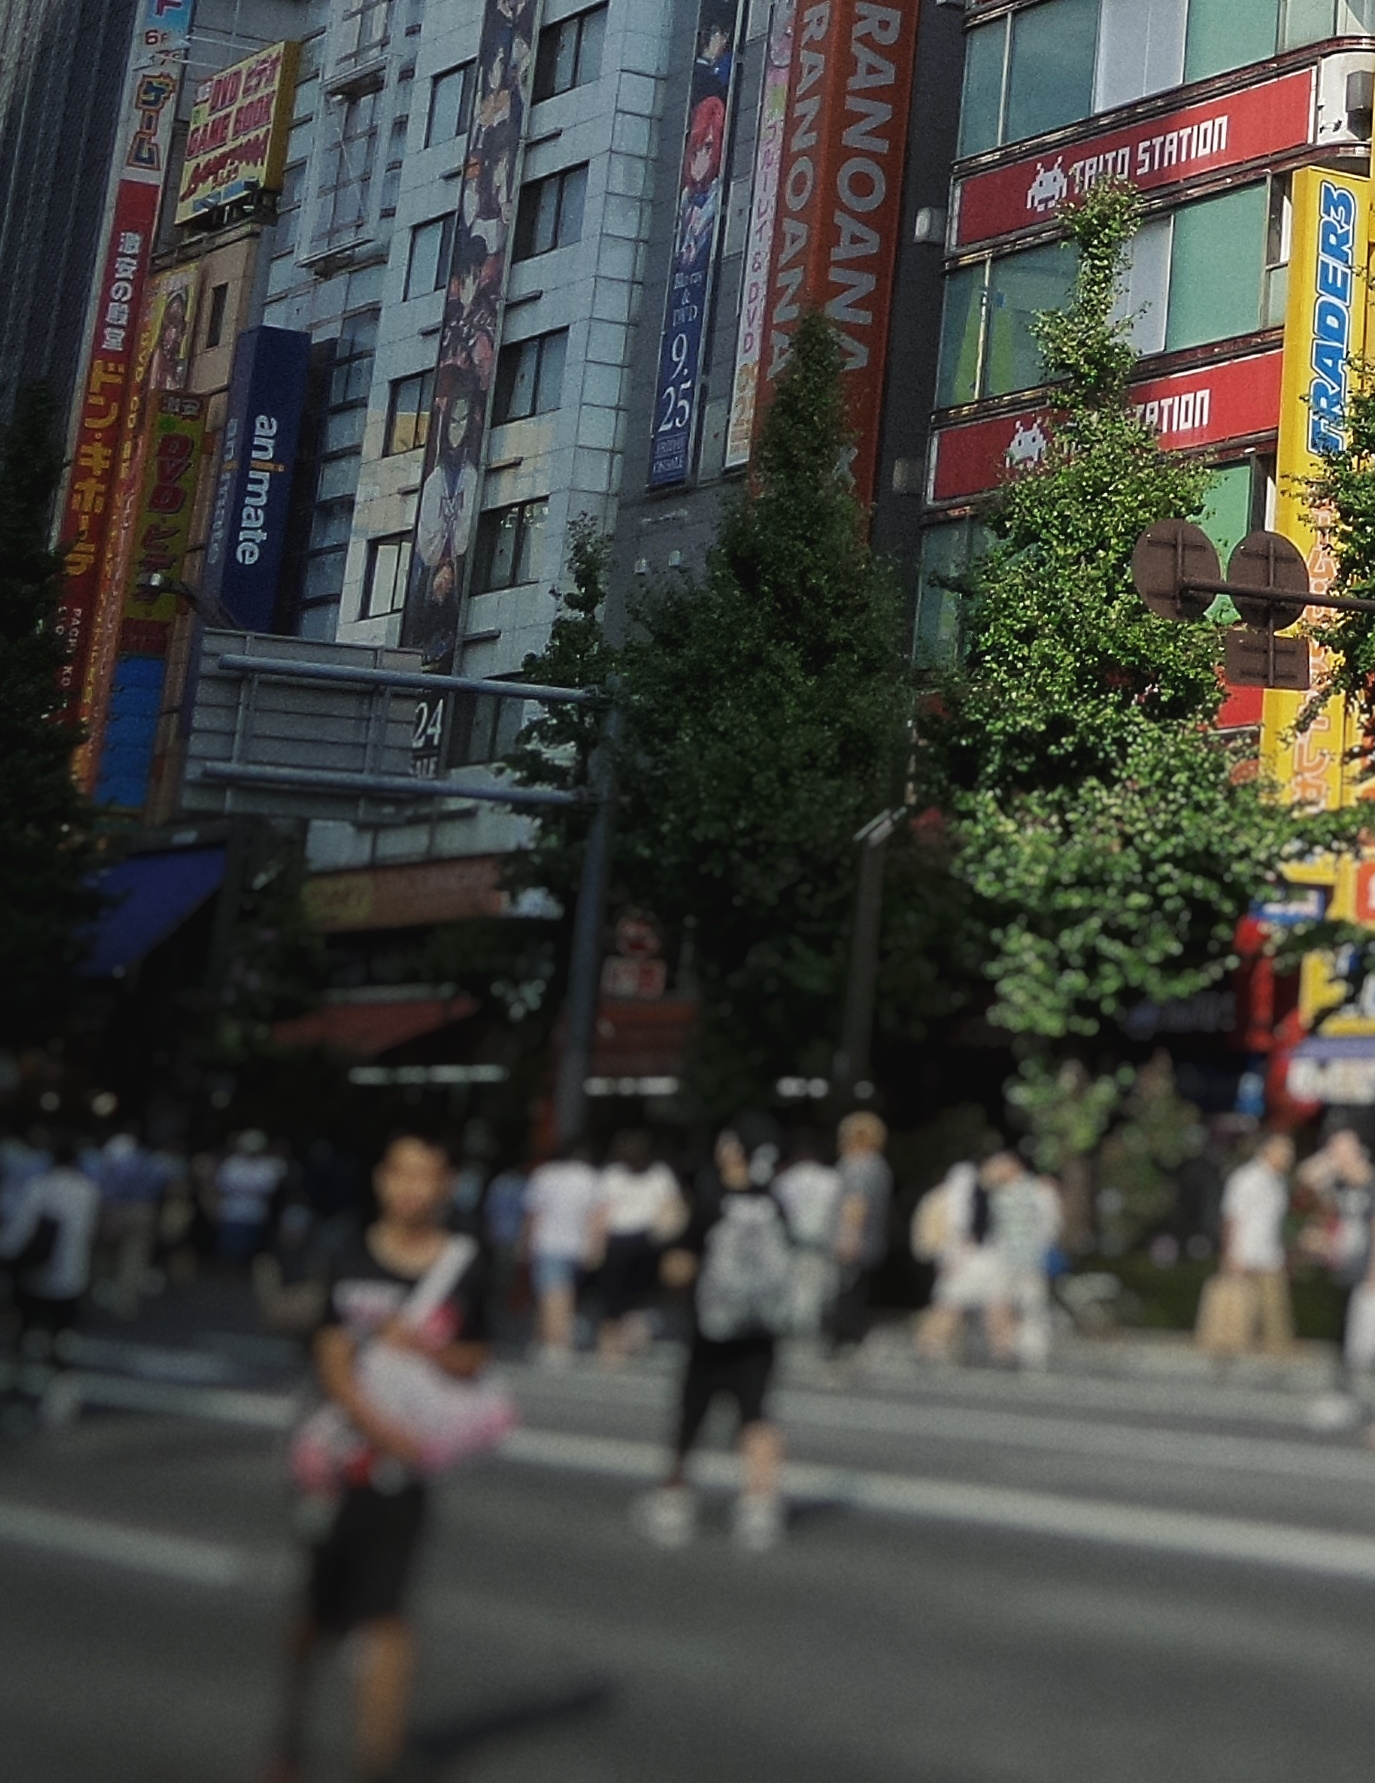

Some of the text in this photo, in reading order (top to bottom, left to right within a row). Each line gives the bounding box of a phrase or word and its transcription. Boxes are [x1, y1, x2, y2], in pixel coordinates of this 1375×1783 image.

[1068, 114, 1229, 195] TAITO STATION
[1306, 181, 1356, 456] TRADER3
[658, 380, 692, 433] 25
[1132, 388, 1211, 436] TATION
[236, 414, 285, 566] animate
[412, 698, 444, 748] 24
